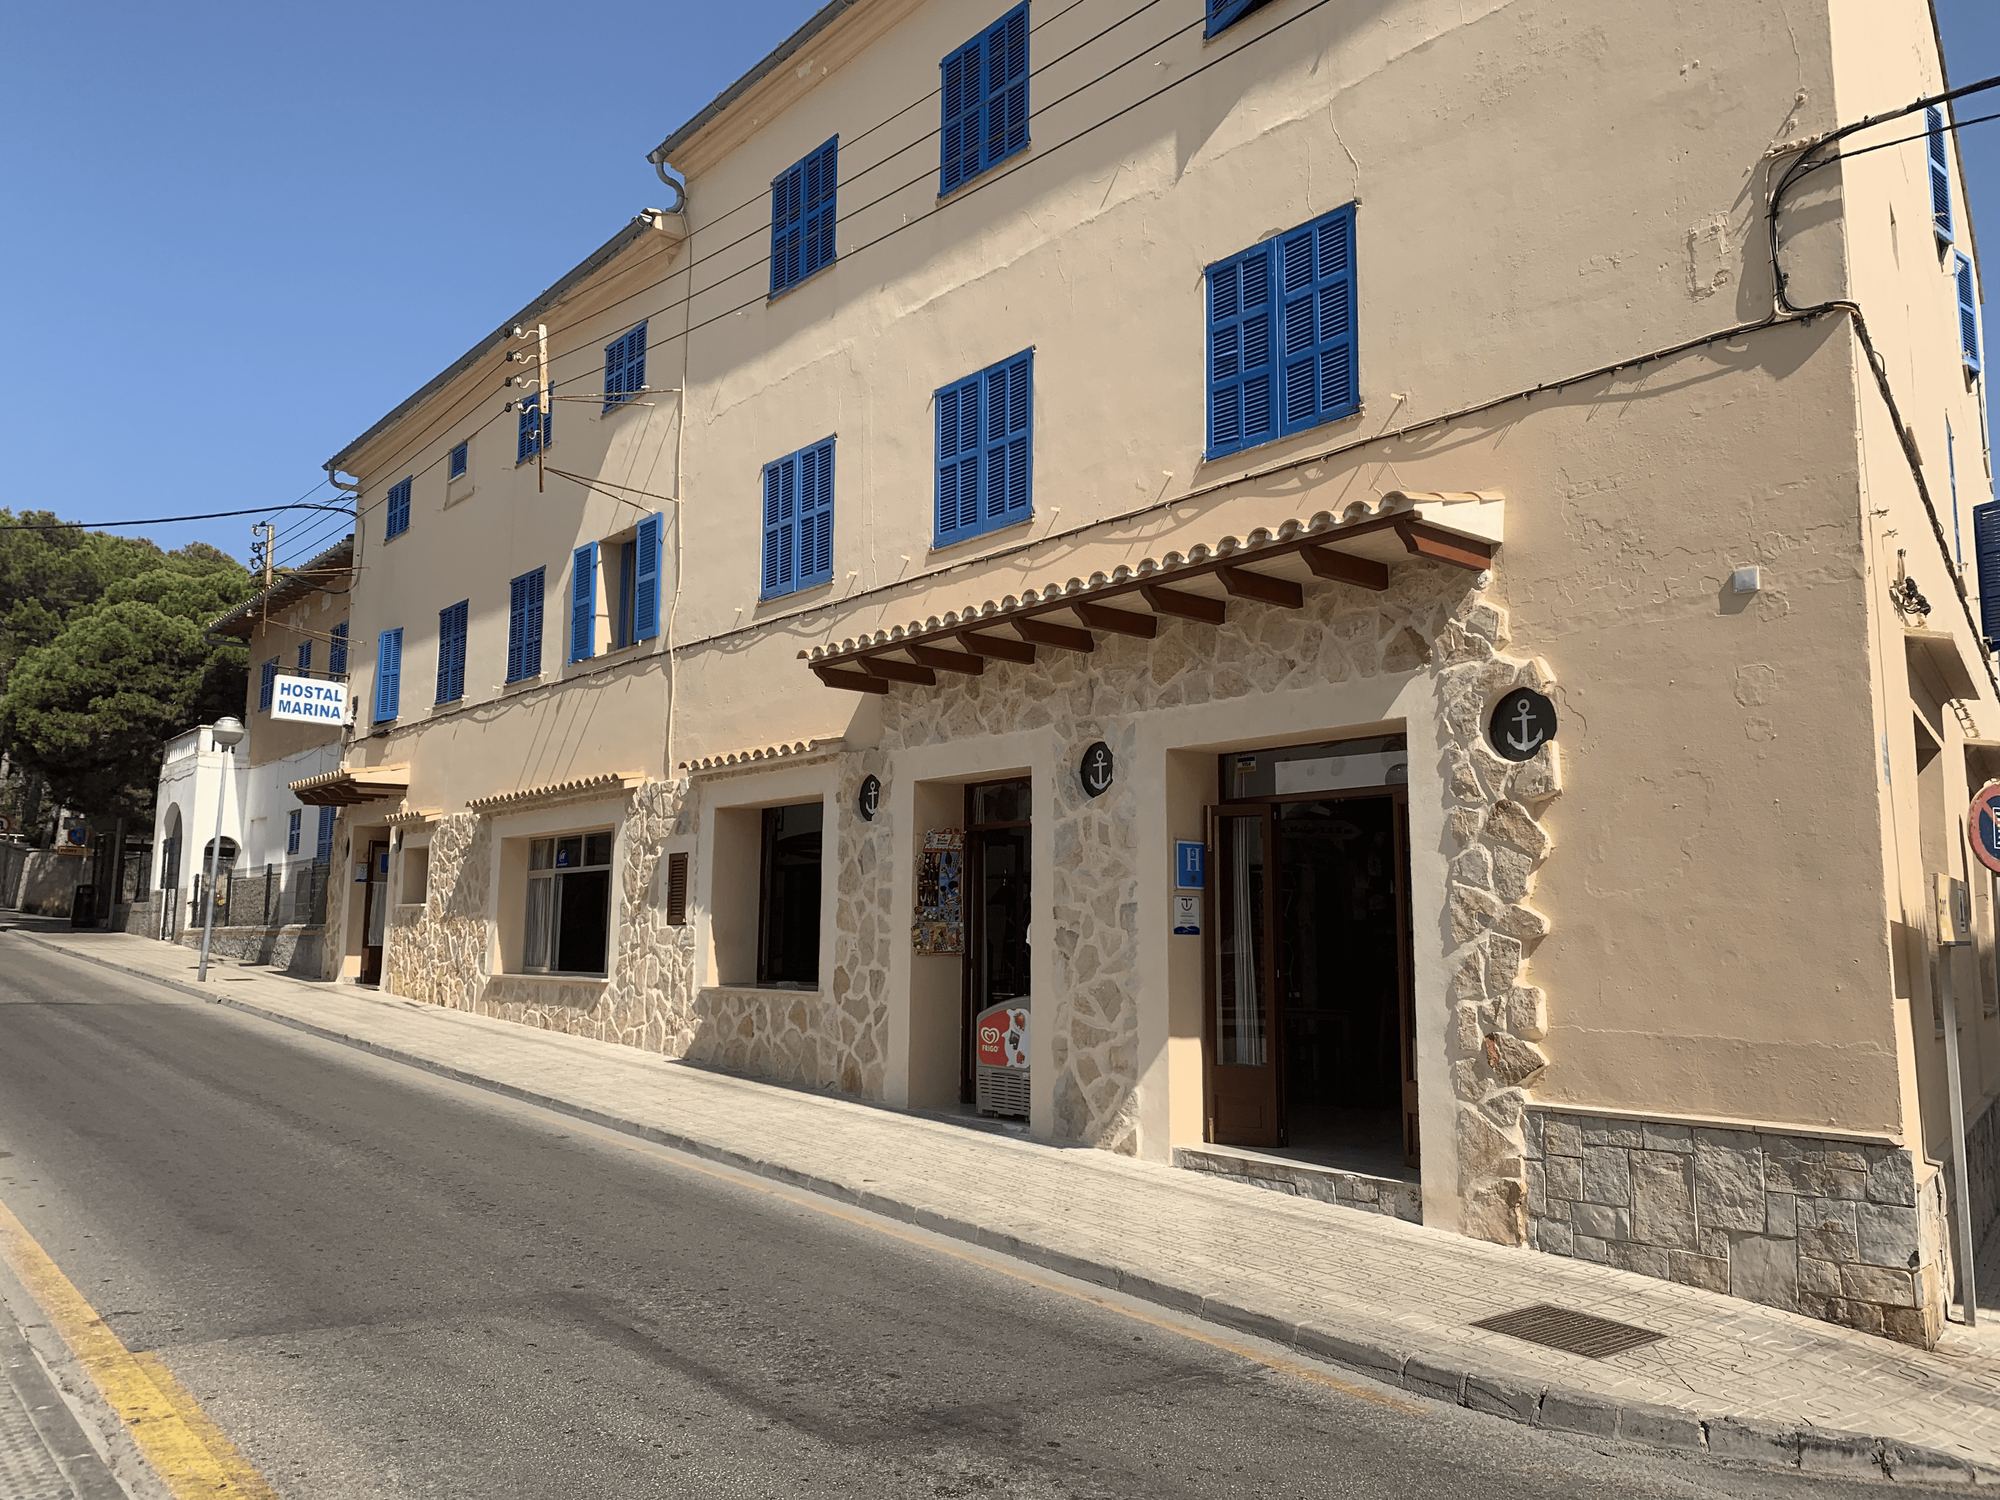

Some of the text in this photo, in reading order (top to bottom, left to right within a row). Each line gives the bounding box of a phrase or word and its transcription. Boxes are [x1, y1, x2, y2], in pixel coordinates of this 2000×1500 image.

[280, 682, 342, 702] HOSTAL
[278, 699, 341, 719] MARINA
[982, 1044, 999, 1053] FRIGO
